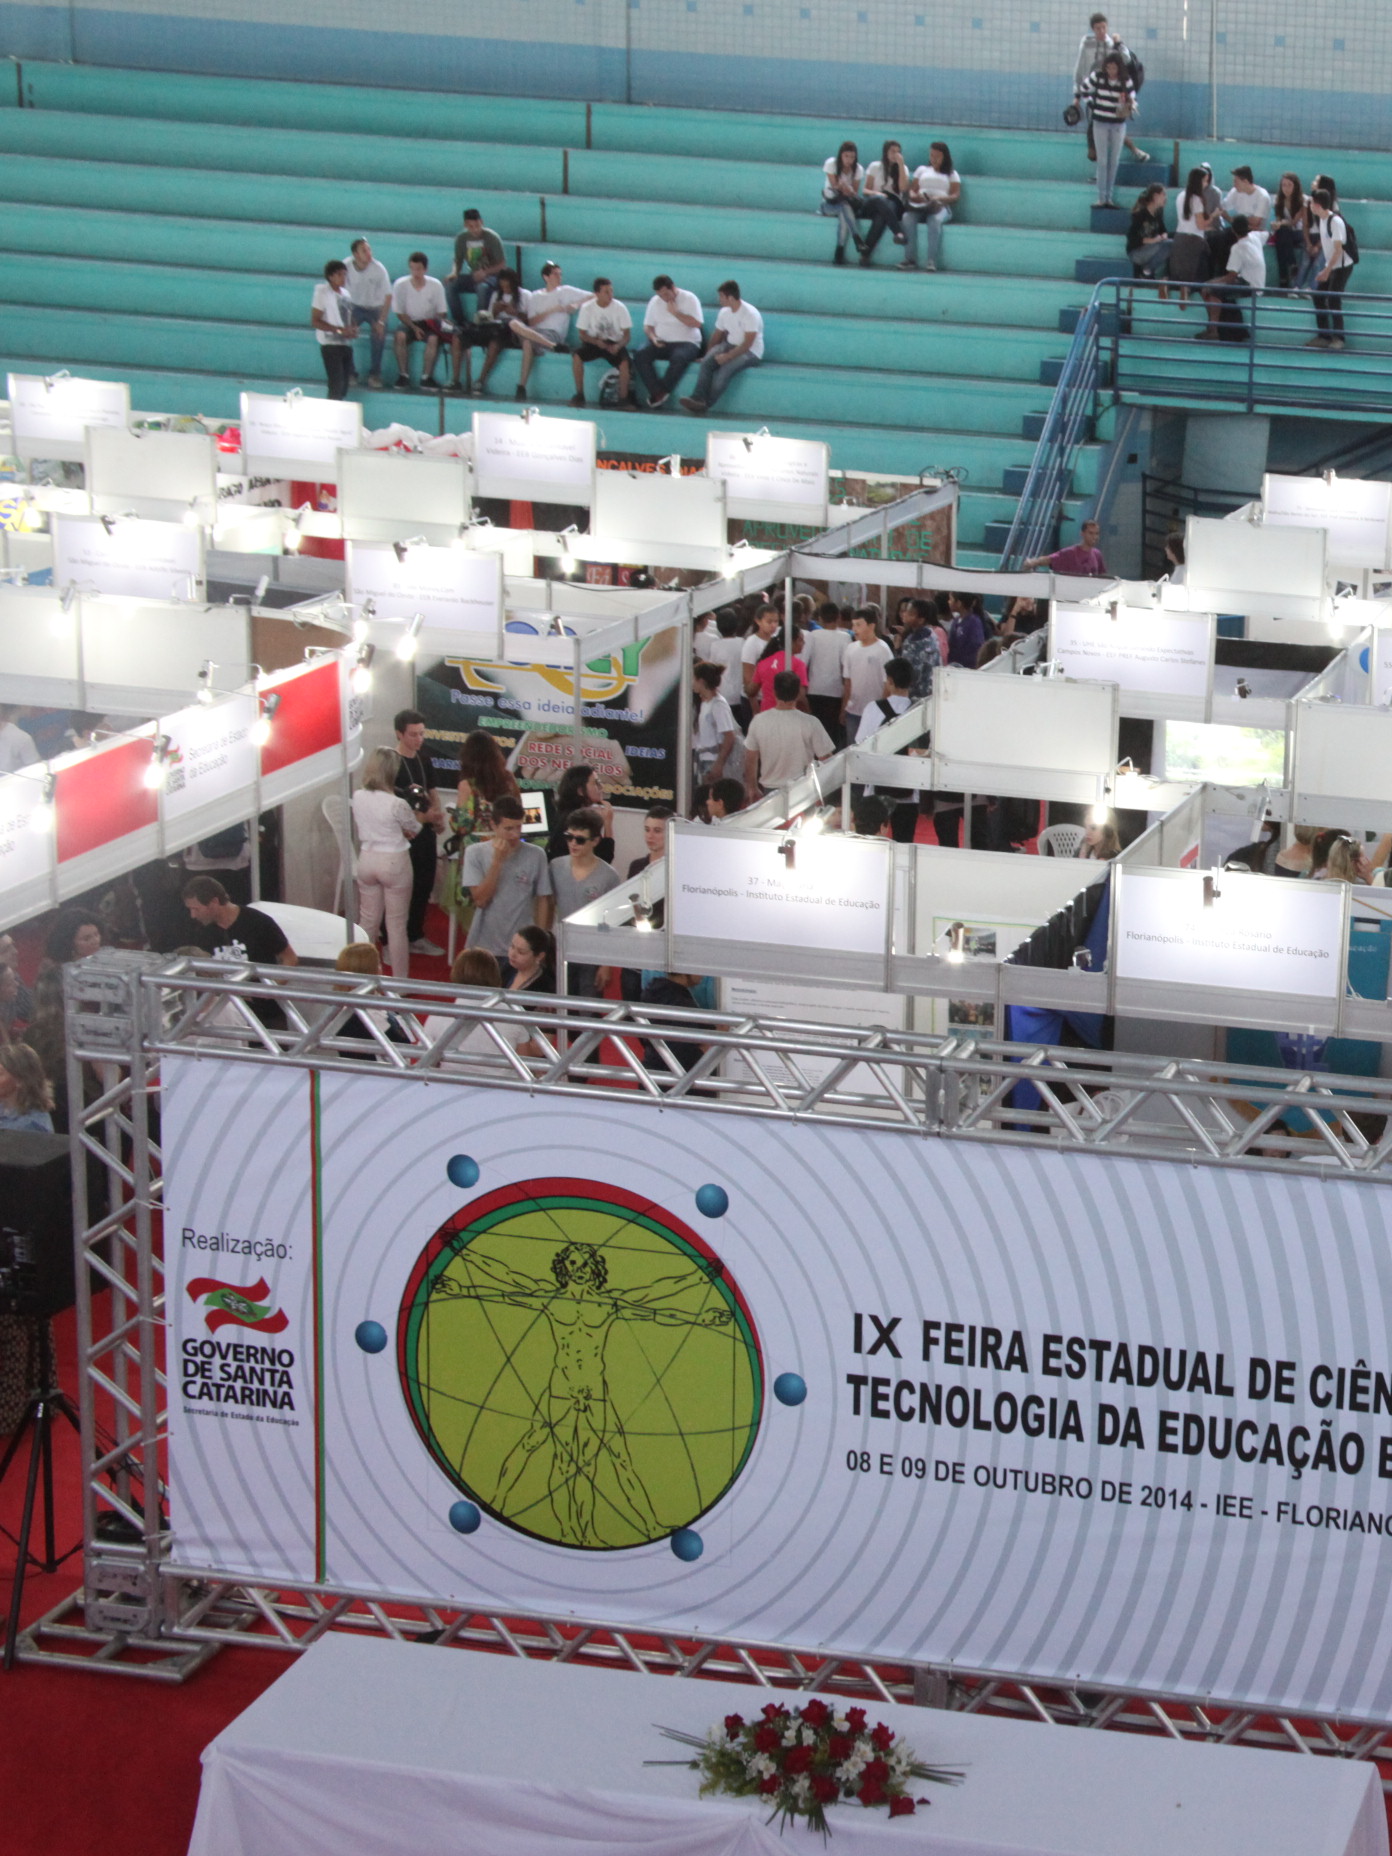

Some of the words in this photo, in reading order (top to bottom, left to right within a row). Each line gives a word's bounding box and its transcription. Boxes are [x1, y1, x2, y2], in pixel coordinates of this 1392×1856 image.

[449, 689, 495, 708] Passe
[499, 696, 532, 711] essa
[537, 698, 576, 715] ideia
[580, 702, 645, 723] adiante!
[517, 754, 549, 769] DOS
[528, 741, 562, 755] REDE
[563, 744, 615, 761] SCIAL
[747, 876, 759, 886] 37
[682, 884, 738, 898] Florianópolis
[746, 890, 784, 902] Instituto
[785, 894, 823, 905] Estadual
[824, 896, 836, 906] de
[838, 898, 880, 910] Educação
[1126, 931, 1184, 945] Florianópolis
[1192, 937, 1230, 950] Instituto
[1232, 941, 1270, 953] Estadual
[1272, 944, 1284, 954] de
[1286, 946, 1330, 960] Educação
[181, 1227, 294, 1262] Realização:
[181, 1338, 295, 1368] GOVERNO
[852, 1312, 903, 1360] IX
[921, 1318, 1030, 1375] FEIRA
[1041, 1332, 1236, 1398] ESTADUAL
[1247, 1356, 1297, 1405] DE
[182, 1358, 213, 1380] DE
[218, 1362, 294, 1390] SANTA
[181, 1380, 296, 1411] CATARINA
[183, 1405, 219, 1418] Secretaria
[220, 1410, 229, 1419] de
[230, 1411, 254, 1422] Estado
[255, 1414, 265, 1422] da
[266, 1415, 300, 1427] Educação
[845, 1372, 1085, 1443] TECNOLOGIA
[1096, 1402, 1146, 1451] DA
[1157, 1409, 1366, 1481] EDUCAÇÃO
[845, 1449, 872, 1474] 08
[878, 1453, 894, 1476] E
[900, 1456, 927, 1480] 09
[933, 1459, 966, 1485] DE
[972, 1464, 1094, 1500] OUTUBRO
[1100, 1480, 1133, 1505] DE
[1139, 1485, 1194, 1512] 2014
[1215, 1493, 1254, 1520] IEE
